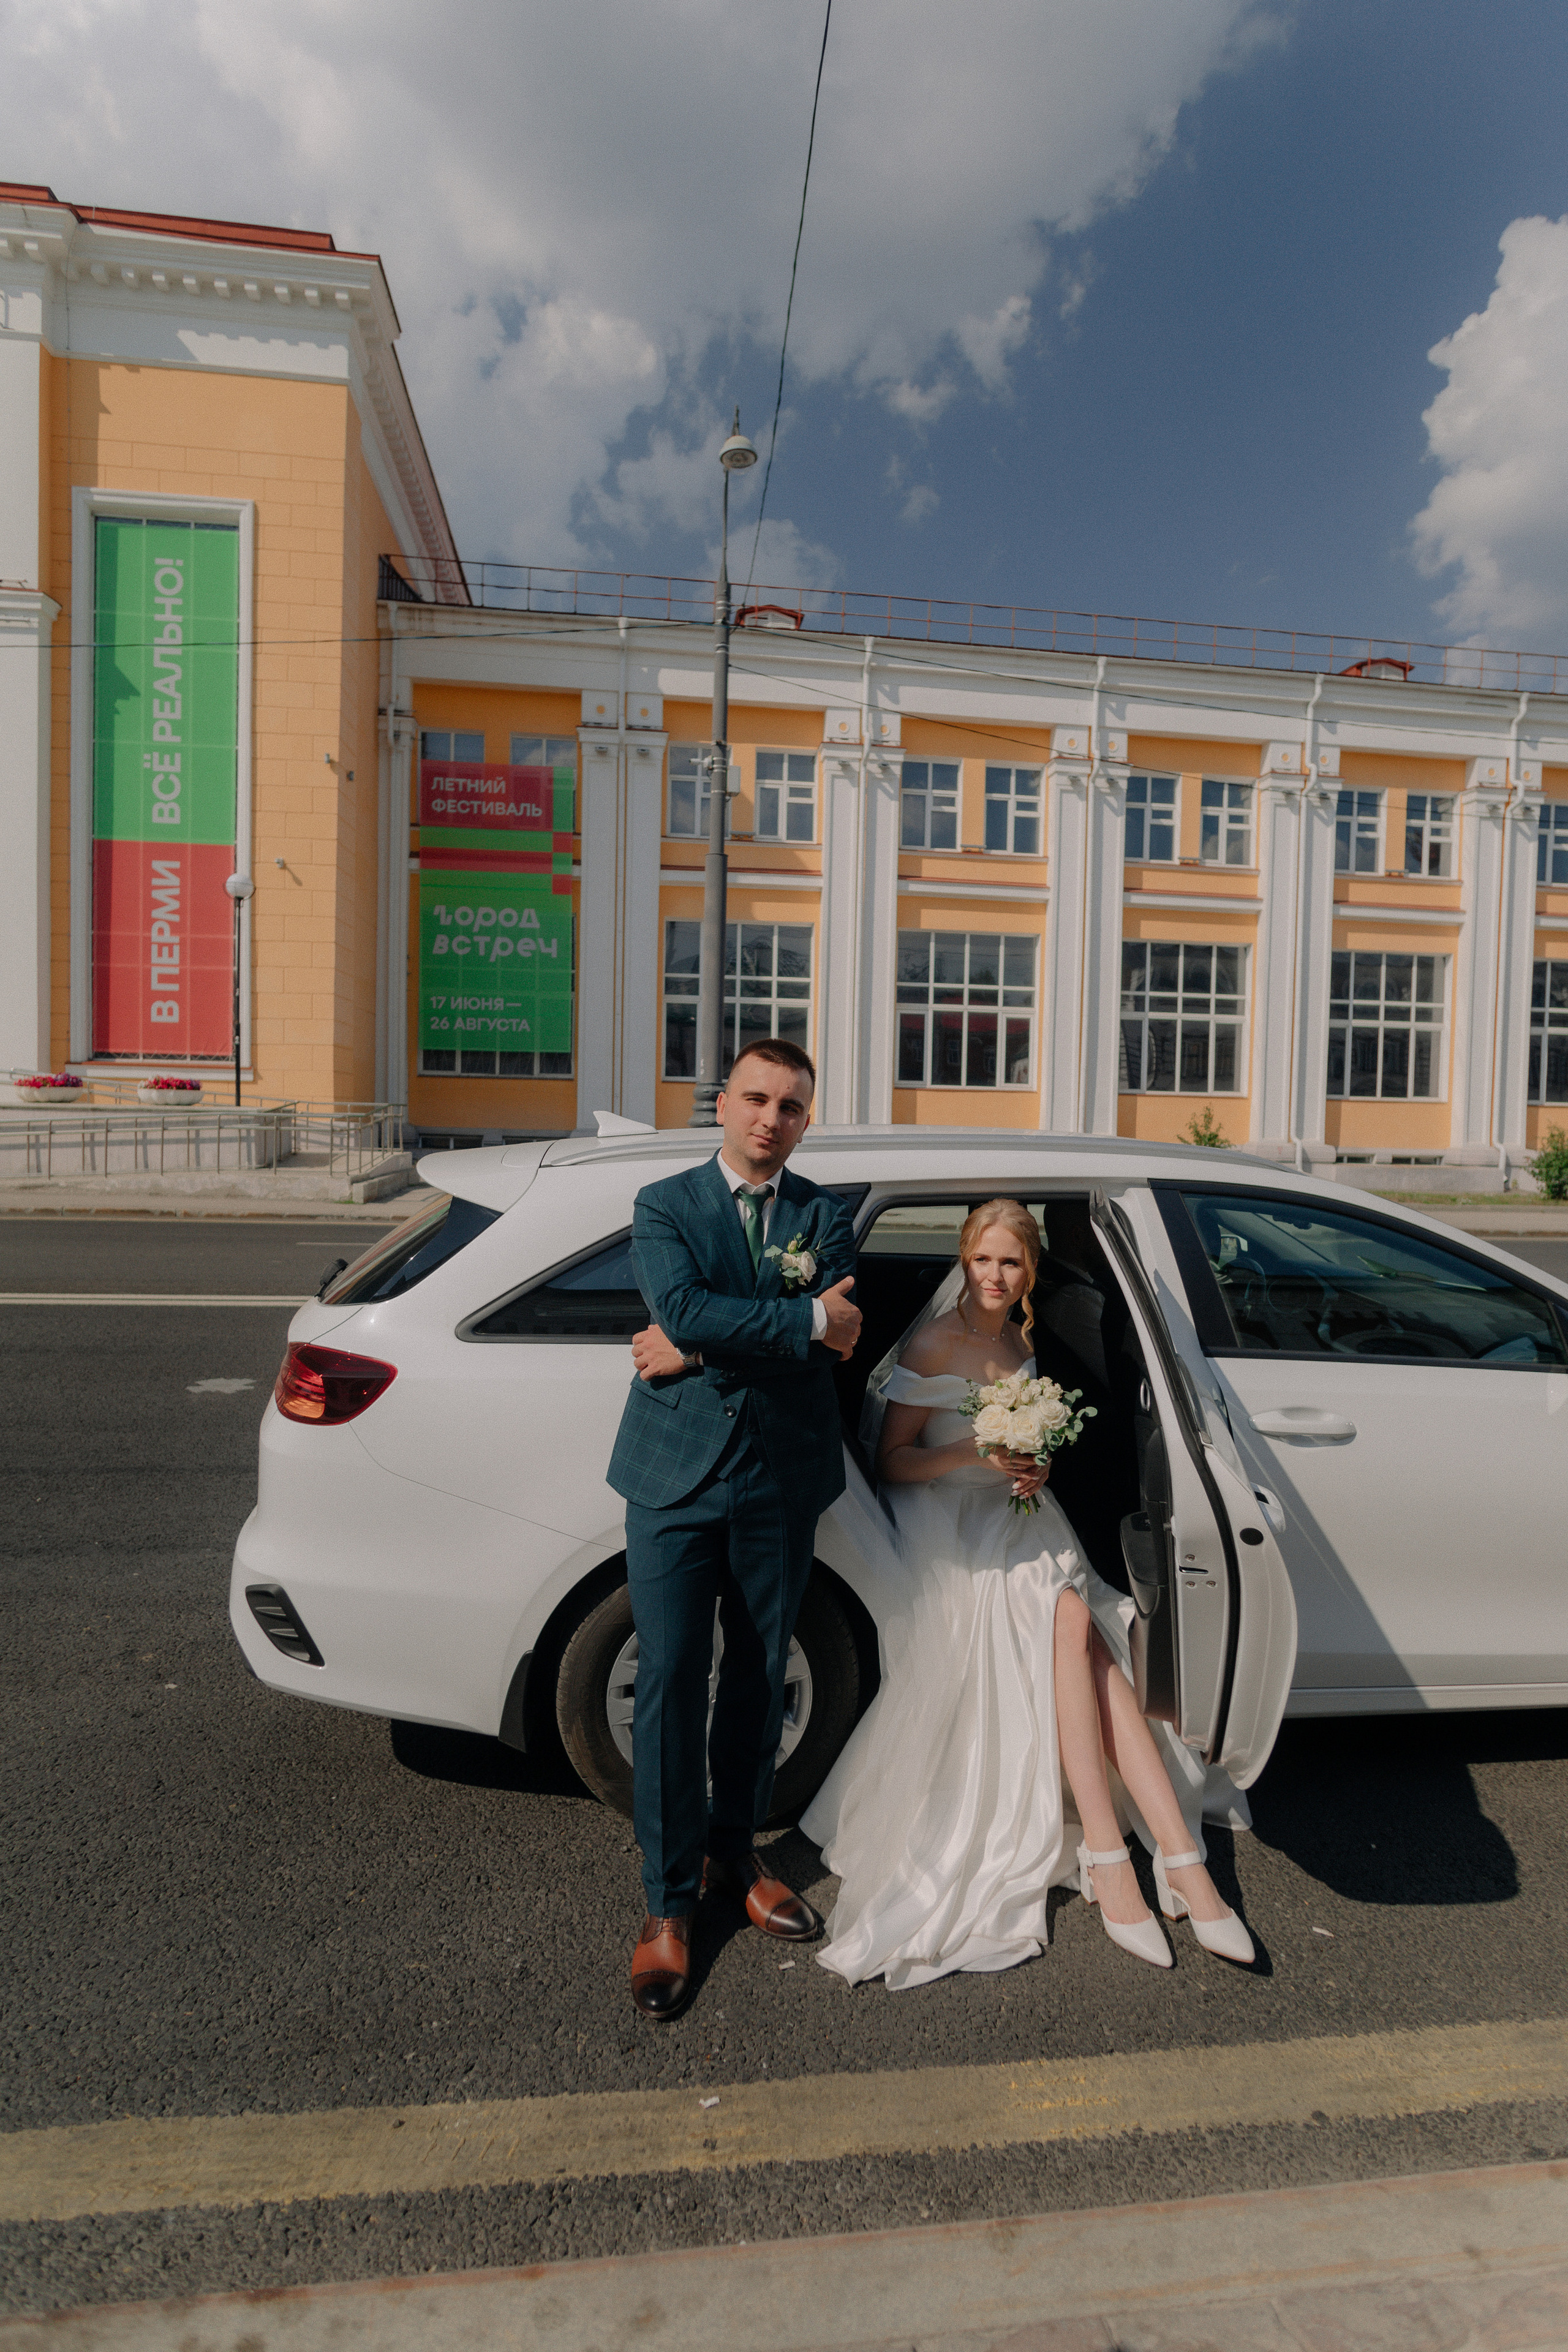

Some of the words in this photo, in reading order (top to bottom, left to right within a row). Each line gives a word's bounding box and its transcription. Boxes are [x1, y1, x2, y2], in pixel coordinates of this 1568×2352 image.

[153, 557, 185, 743] РЕАЛЬНО!
[143, 751, 182, 825] ВСЁ
[431, 776, 506, 794] ЛЕТНИЙ
[431, 798, 543, 816] ФЕСТИВАЛЬ
[151, 860, 181, 991] ПЕРМИ
[432, 934, 557, 962] встреч
[151, 1000, 179, 1023] В
[430, 996, 447, 1009] 17
[430, 1017, 450, 1030] 26
[454, 1017, 531, 1031] АВГУСТА
